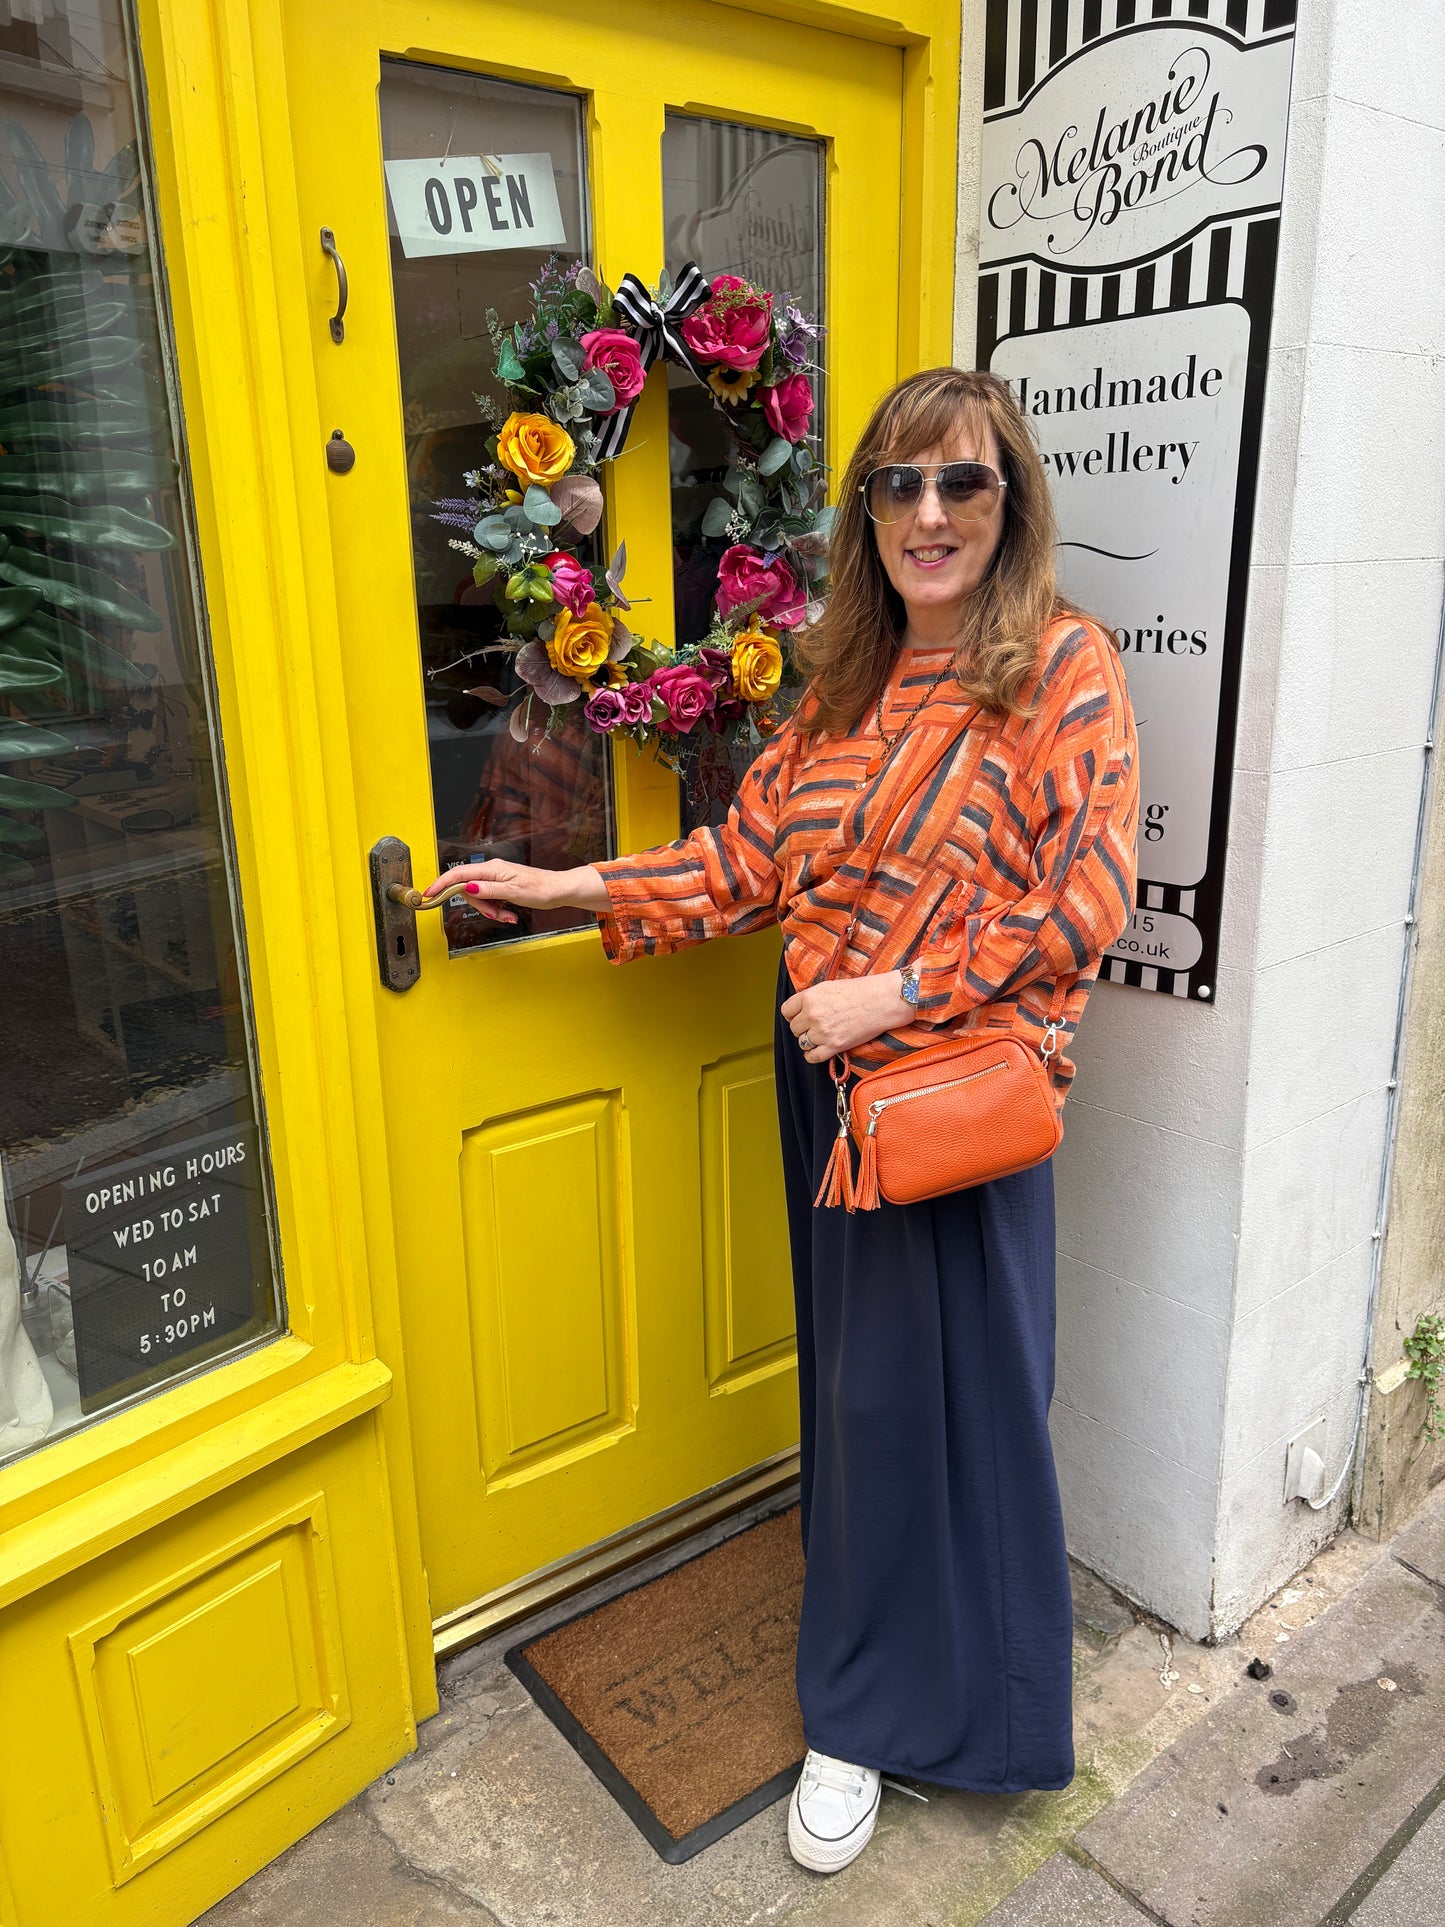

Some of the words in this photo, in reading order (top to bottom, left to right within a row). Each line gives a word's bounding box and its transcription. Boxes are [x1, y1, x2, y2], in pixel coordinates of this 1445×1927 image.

[988, 47, 1210, 229] Melanie
[1132, 110, 1212, 166] Boutique
[1048, 92, 1268, 254] Bond
[424, 174, 535, 236] OPEN
[1038, 431, 1200, 485] ewellery
[1116, 614, 1208, 656] ories
[1111, 938, 1170, 959] .co.uk
[85, 1166, 176, 1215] OPENING
[186, 1142, 246, 1179] HOURS
[113, 1219, 155, 1249] WED
[160, 1208, 184, 1232] TO
[187, 1194, 222, 1223] SAT
[160, 1287, 186, 1313] TO
